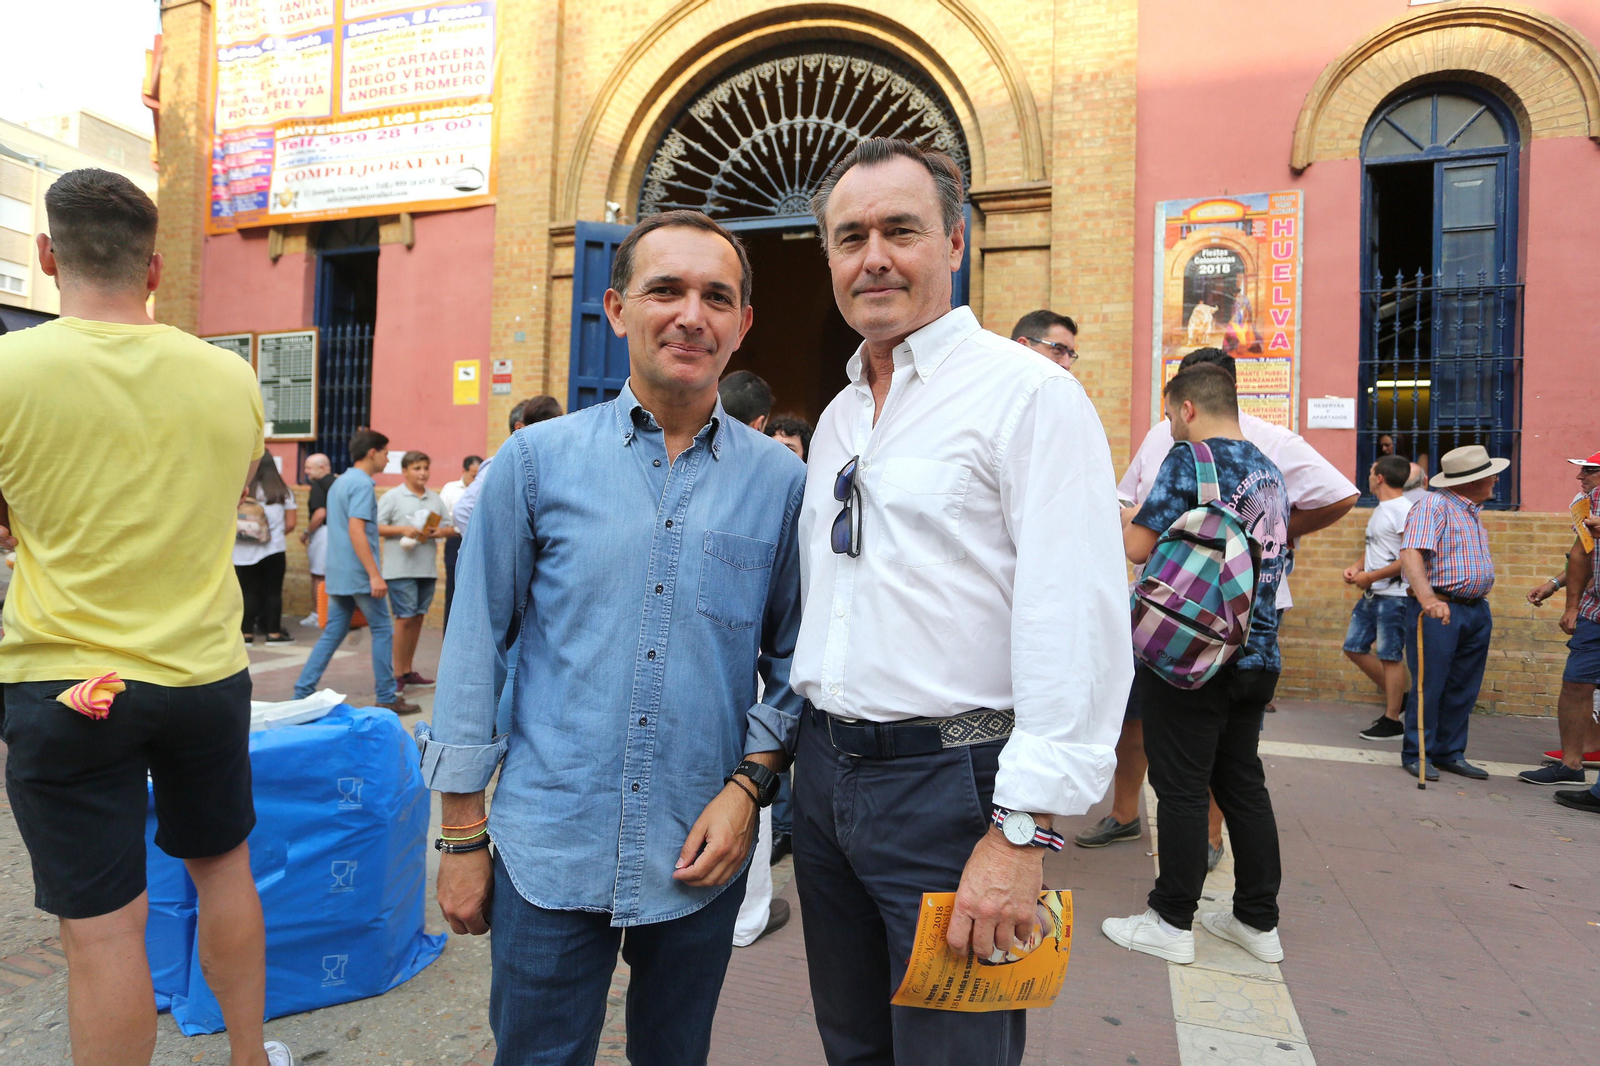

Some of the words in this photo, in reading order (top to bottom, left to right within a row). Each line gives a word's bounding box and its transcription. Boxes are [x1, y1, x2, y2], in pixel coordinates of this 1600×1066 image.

[387, 46, 486, 67] CARTAGENA
[349, 71, 396, 89] DIEGO
[403, 60, 486, 78] VENTURA
[266, 85, 325, 100] PERERA
[348, 83, 408, 102] ANDRES
[414, 75, 486, 92] ROMERO
[228, 106, 270, 120] ROCA
[274, 99, 307, 111] REY
[276, 118, 380, 139] MANTENEMOS
[384, 112, 416, 125] LOS
[419, 102, 494, 122] PRECIOS
[280, 138, 320, 151] Telf.
[329, 134, 368, 146] 959
[377, 129, 400, 141] 28
[413, 124, 434, 135] 15
[445, 118, 472, 131] 00
[284, 163, 383, 184] COMPLEJO
[389, 153, 466, 172] RAFAEL
[1194, 256, 1235, 265] Colombinas
[1202, 249, 1228, 257] Fiestas
[1199, 264, 1231, 274] 2018
[1268, 218, 1294, 350] HUELVA
[932, 905, 944, 929] 2018
[938, 905, 952, 942] agosto
[916, 936, 925, 958] TEATRO
[921, 911, 929, 932] DANZA
[943, 976, 955, 991] Lear
[962, 970, 972, 979] es
[924, 984, 940, 1001] Nerón
[937, 991, 950, 1002] Rey
[956, 979, 969, 995] vida
[953, 994, 963, 1002] La
